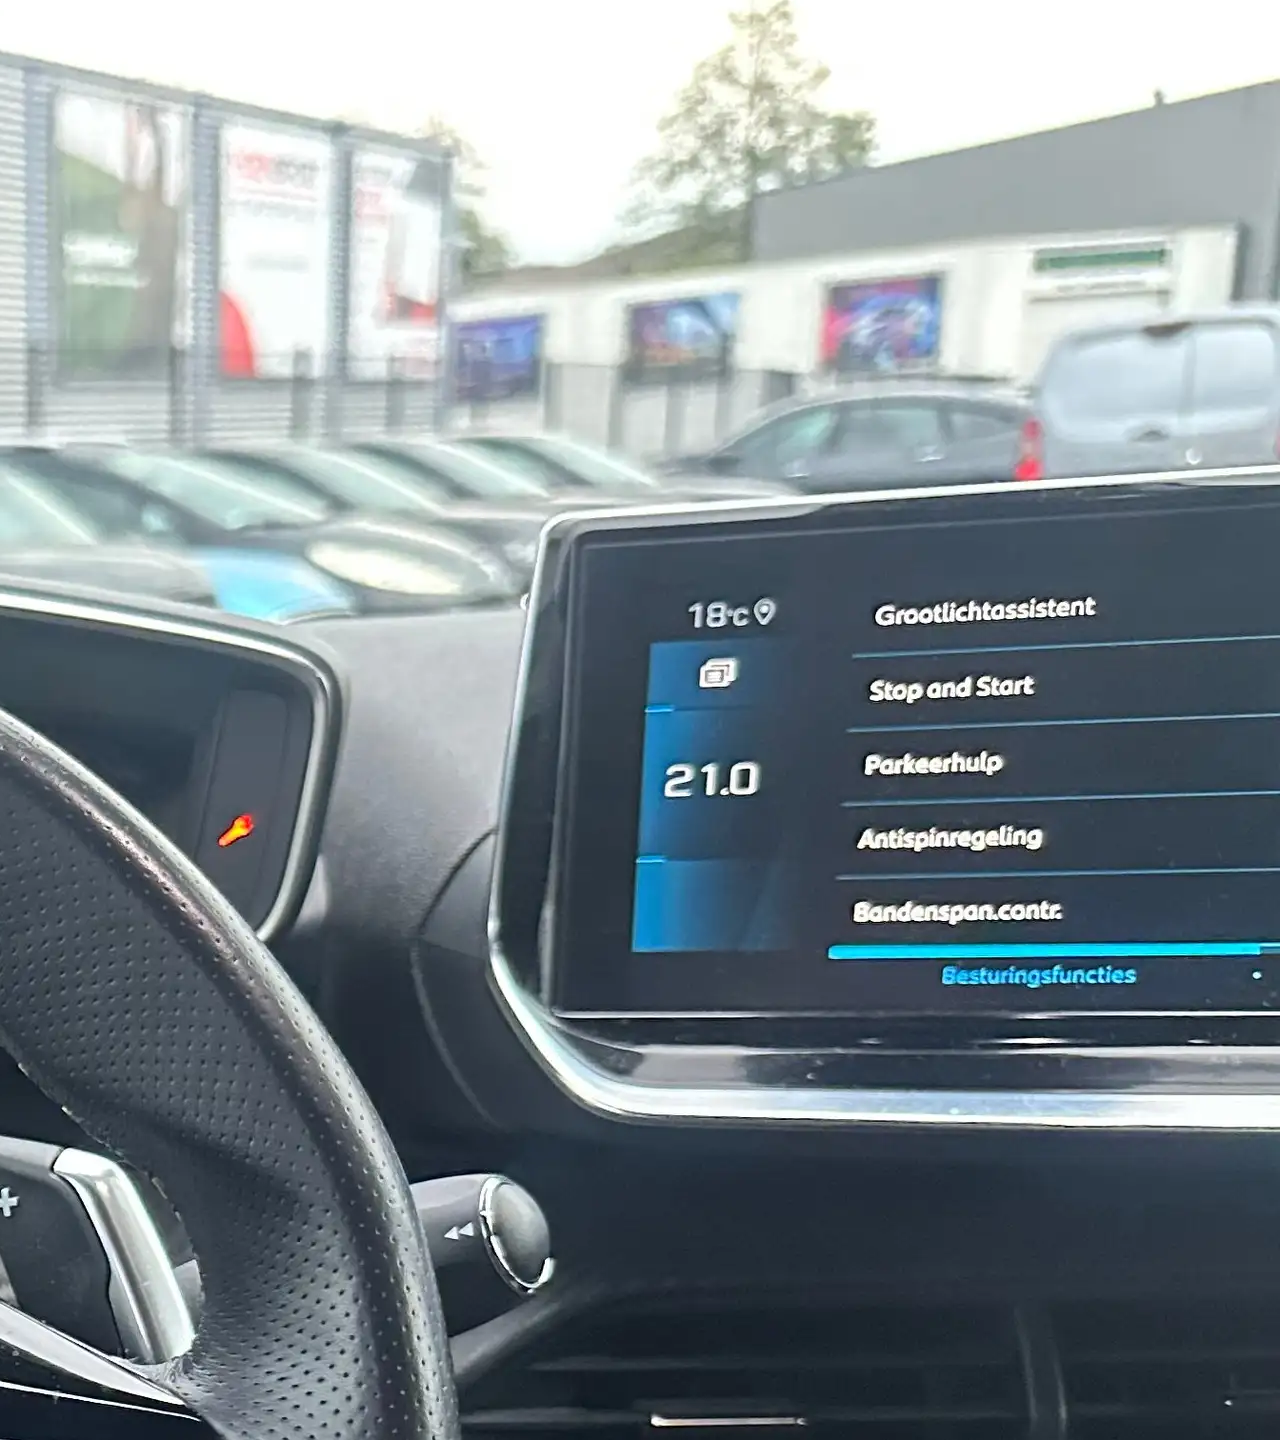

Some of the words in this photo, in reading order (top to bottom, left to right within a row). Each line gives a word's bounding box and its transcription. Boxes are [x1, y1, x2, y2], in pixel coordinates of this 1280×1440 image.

[873, 596, 1097, 628] Grootlichtassistent
[868, 679, 925, 705] Stop
[926, 677, 973, 700] and
[975, 674, 1035, 698] Start
[864, 749, 1004, 777] Parkeerhulp
[664, 761, 760, 798] 21.0
[856, 825, 1044, 852] Antispinregeling
[852, 900, 1063, 926] Bandenspan.contr.
[941, 964, 1137, 989] Besturingsfuncties
